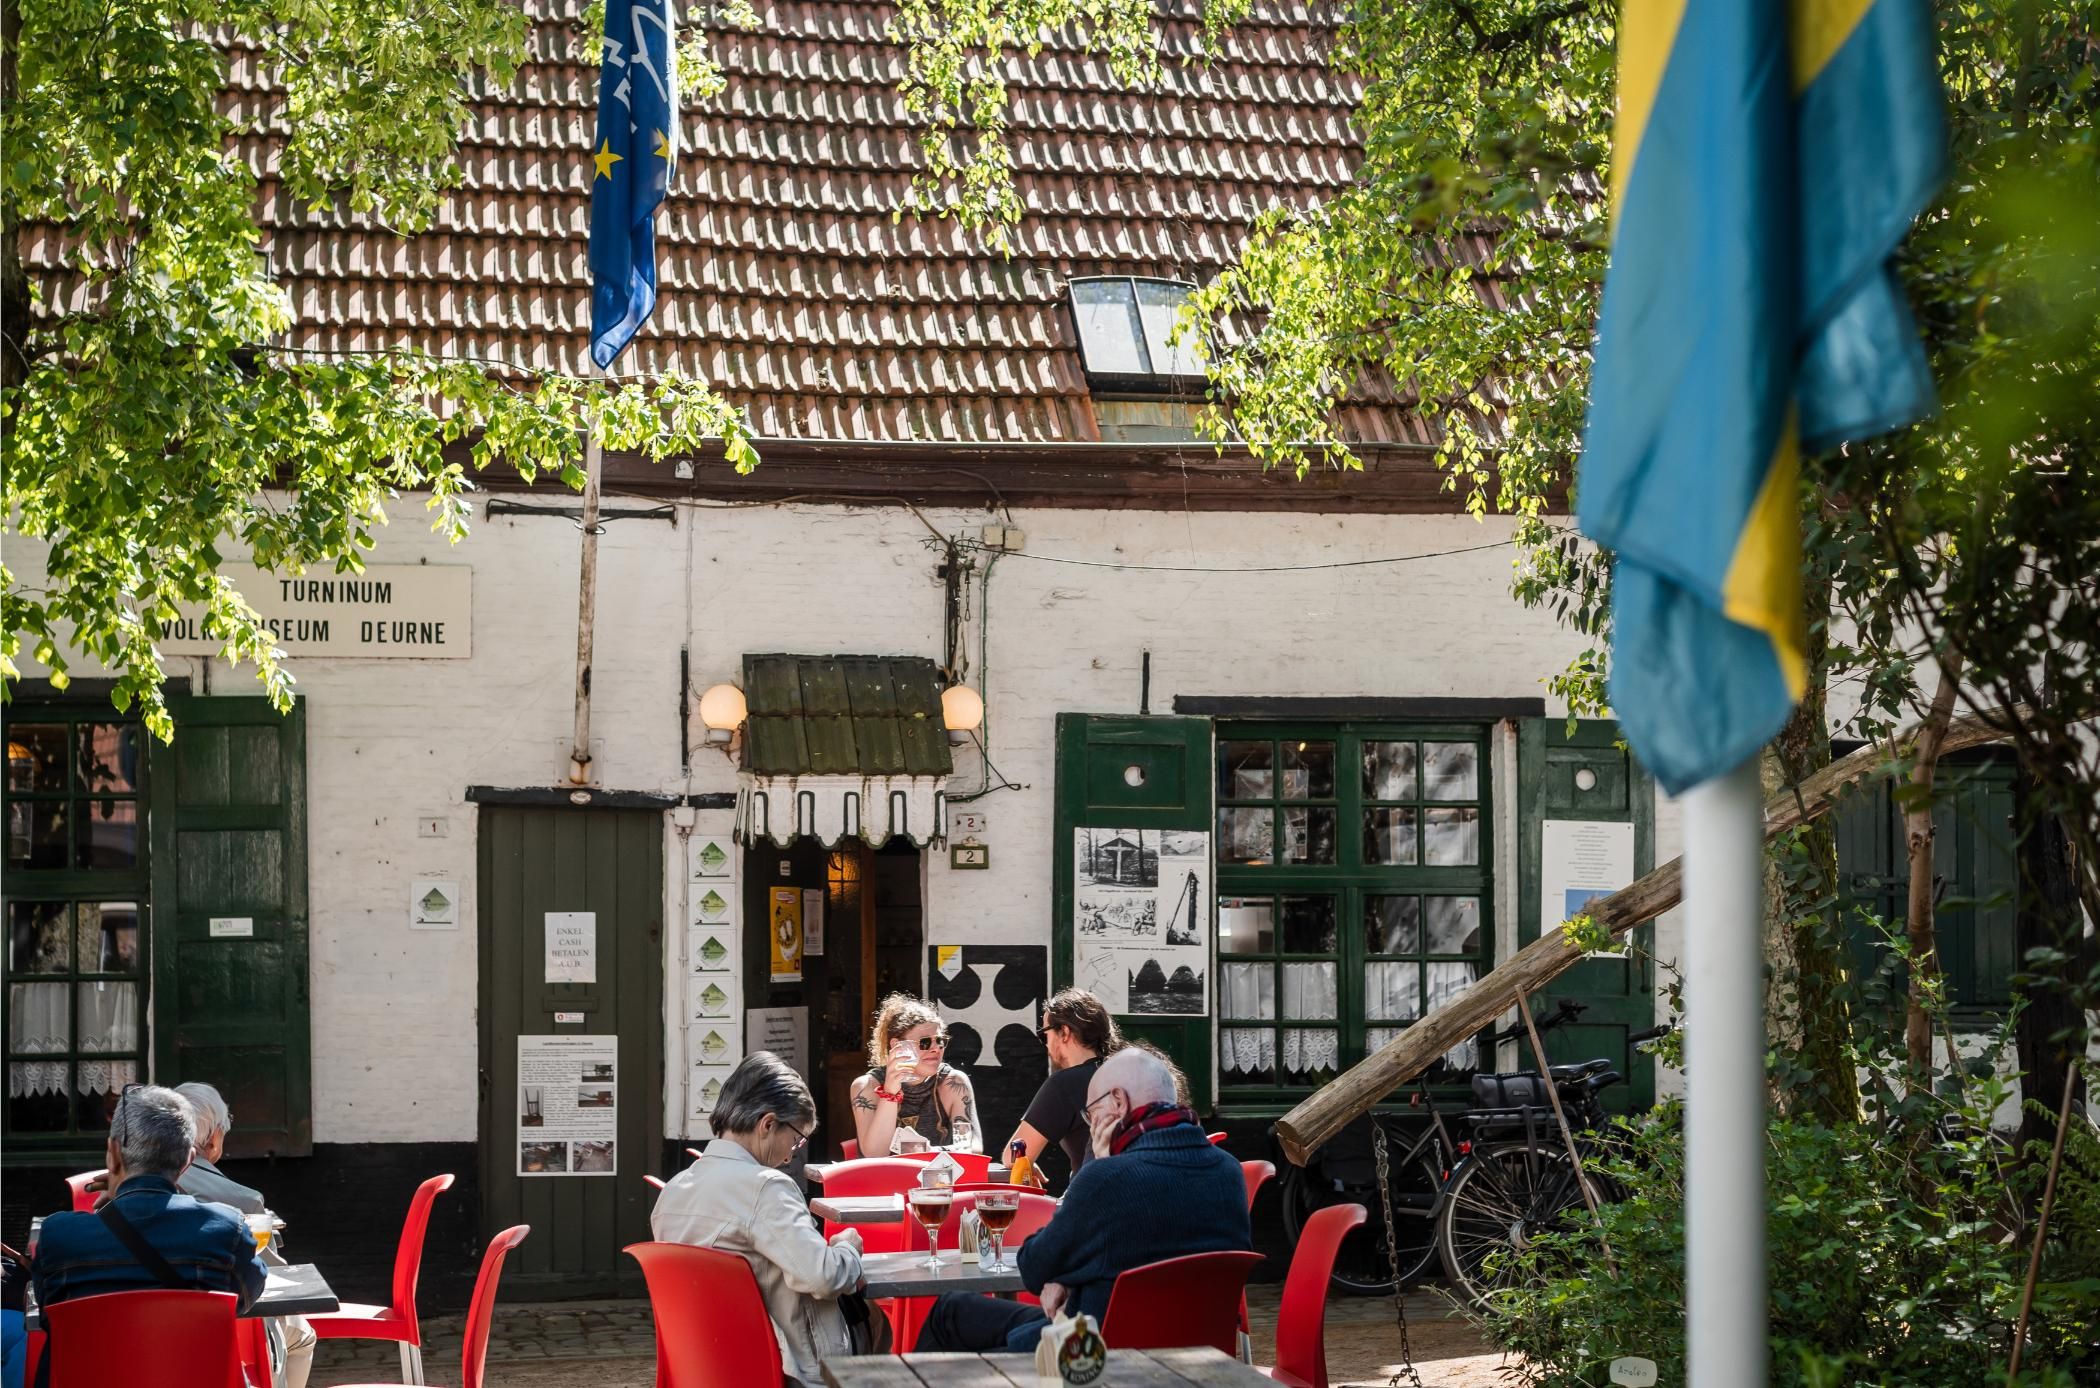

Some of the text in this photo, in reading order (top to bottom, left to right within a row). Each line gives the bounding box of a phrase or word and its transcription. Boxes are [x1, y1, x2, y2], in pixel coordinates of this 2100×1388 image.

[279, 579, 392, 604] TURNINUM
[161, 618, 446, 645] VOLKSEUM DEURNE
[432, 822, 437, 833] 1
[967, 817, 975, 828] 2
[966, 850, 975, 863] 2
[556, 927, 585, 936] ENKEL
[558, 938, 582, 947] CASH
[551, 949, 590, 958] BETALEN
